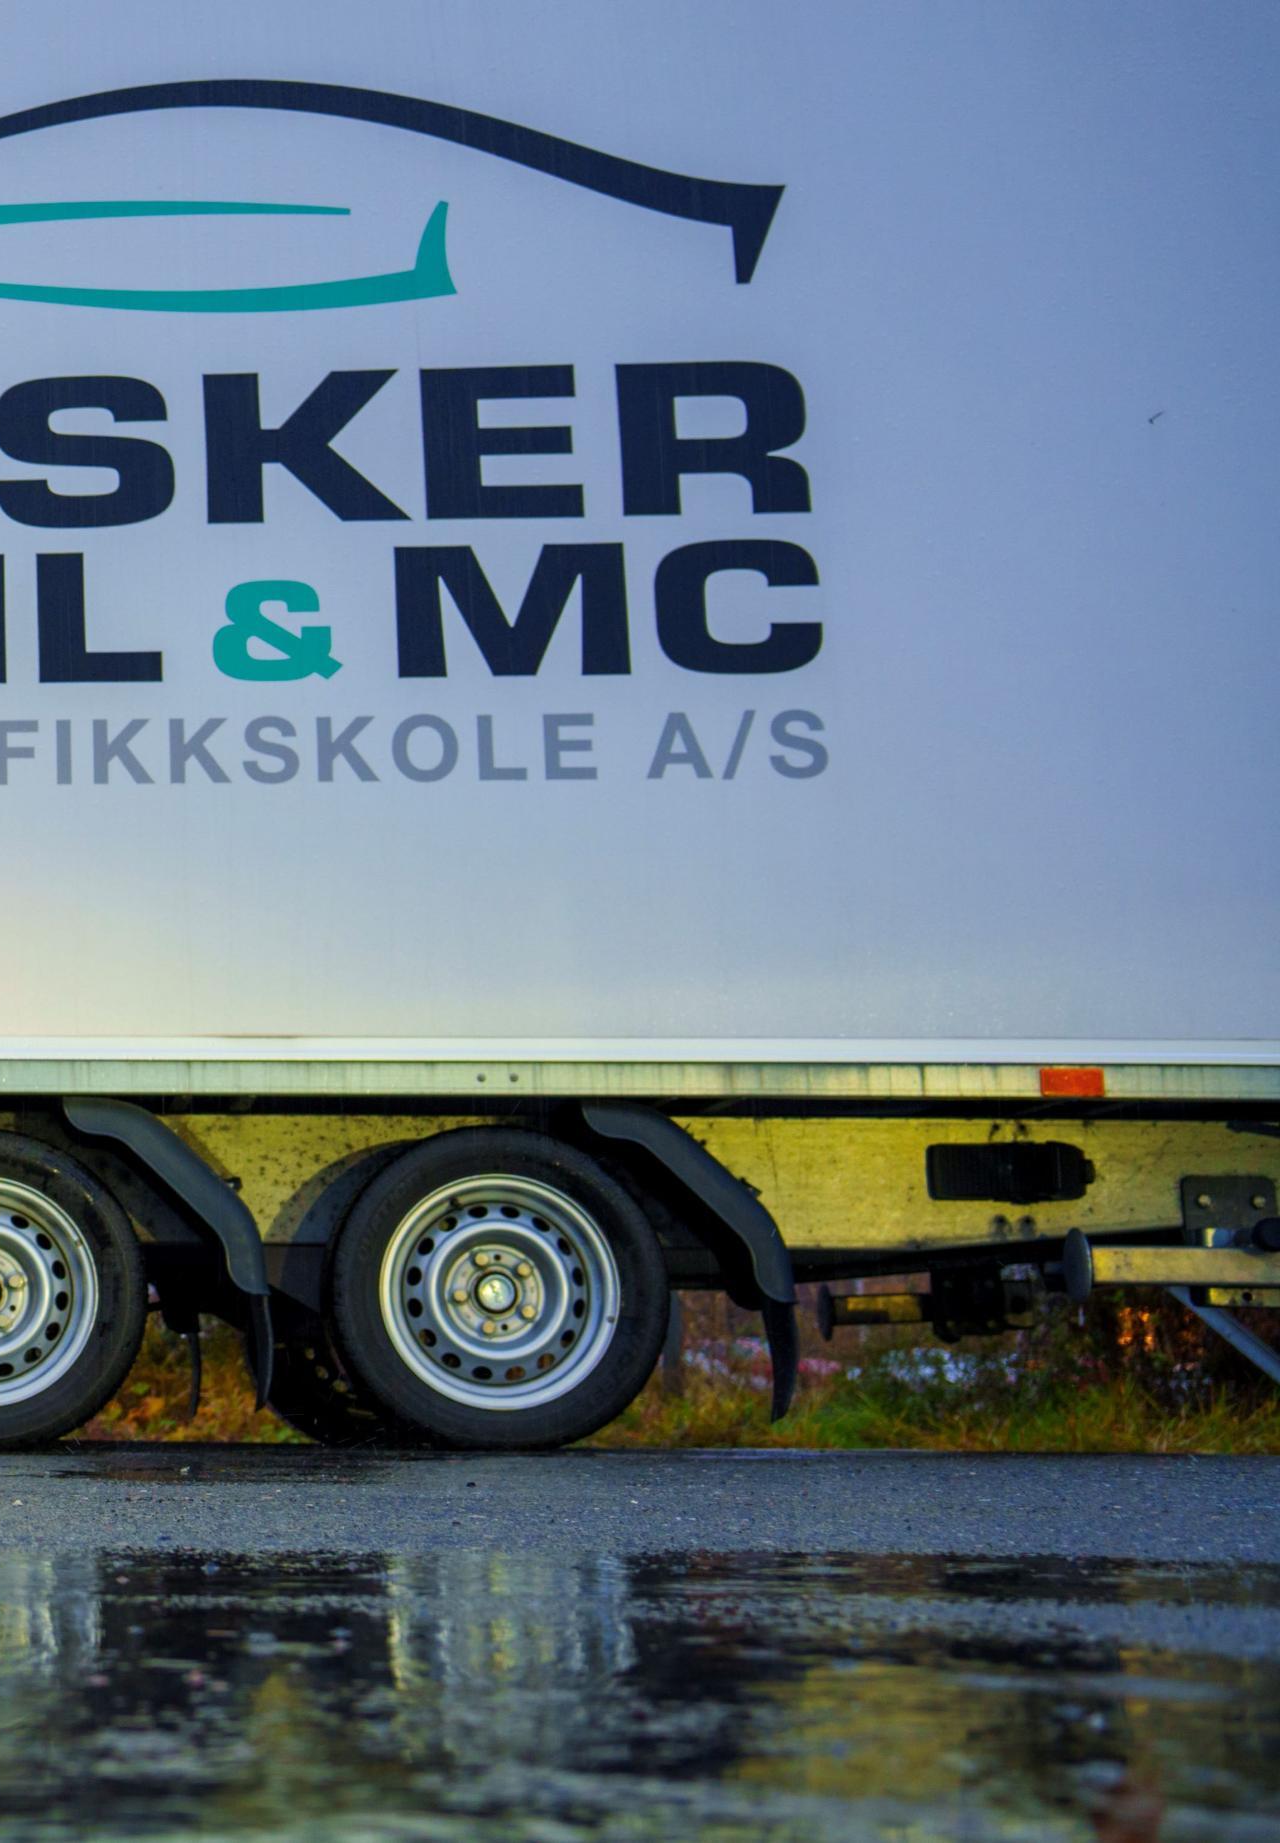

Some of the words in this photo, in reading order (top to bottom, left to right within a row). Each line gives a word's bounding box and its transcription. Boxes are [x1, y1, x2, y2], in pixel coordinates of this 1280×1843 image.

[212, 579, 343, 682] &
[393, 538, 824, 679] MC
[646, 708, 830, 780] A/S
